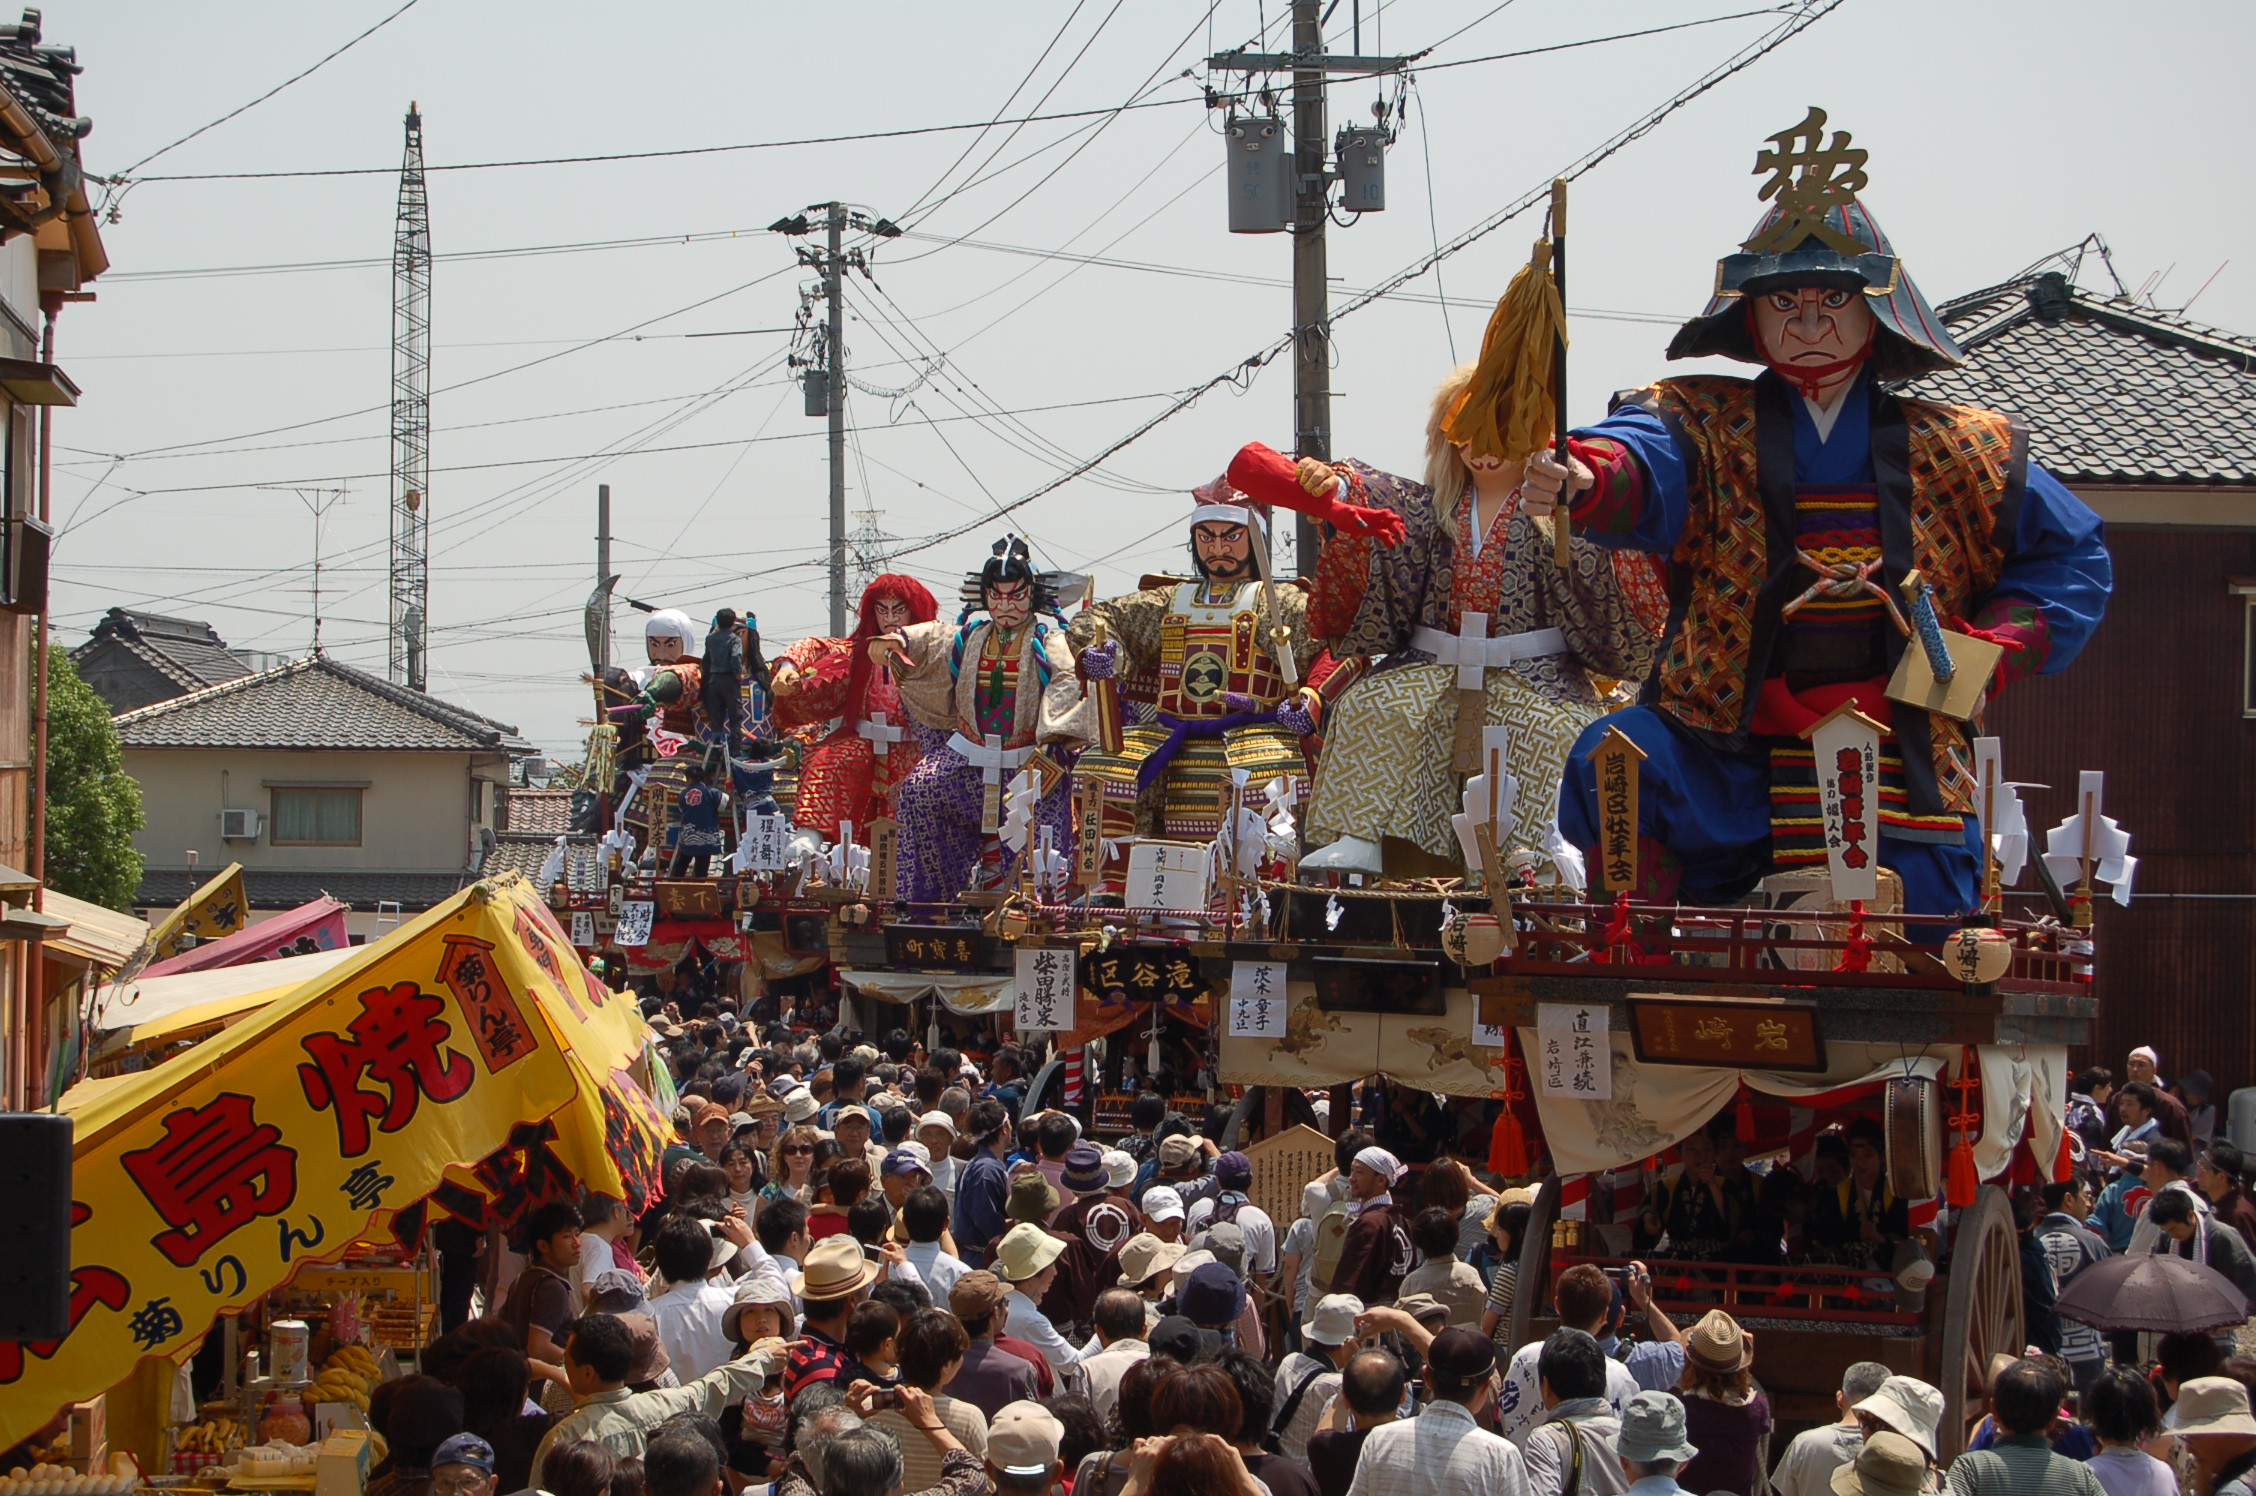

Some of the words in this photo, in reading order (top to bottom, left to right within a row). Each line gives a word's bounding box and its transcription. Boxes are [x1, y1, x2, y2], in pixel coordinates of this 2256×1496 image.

[1363, 183, 1379, 200] 10
[652, 787, 664, 846] 明智光秀
[1032, 951, 1059, 1027] 柴田勝家
[1253, 965, 1272, 1031] 茨木童子
[1571, 1008, 1597, 1092] 直江兼続
